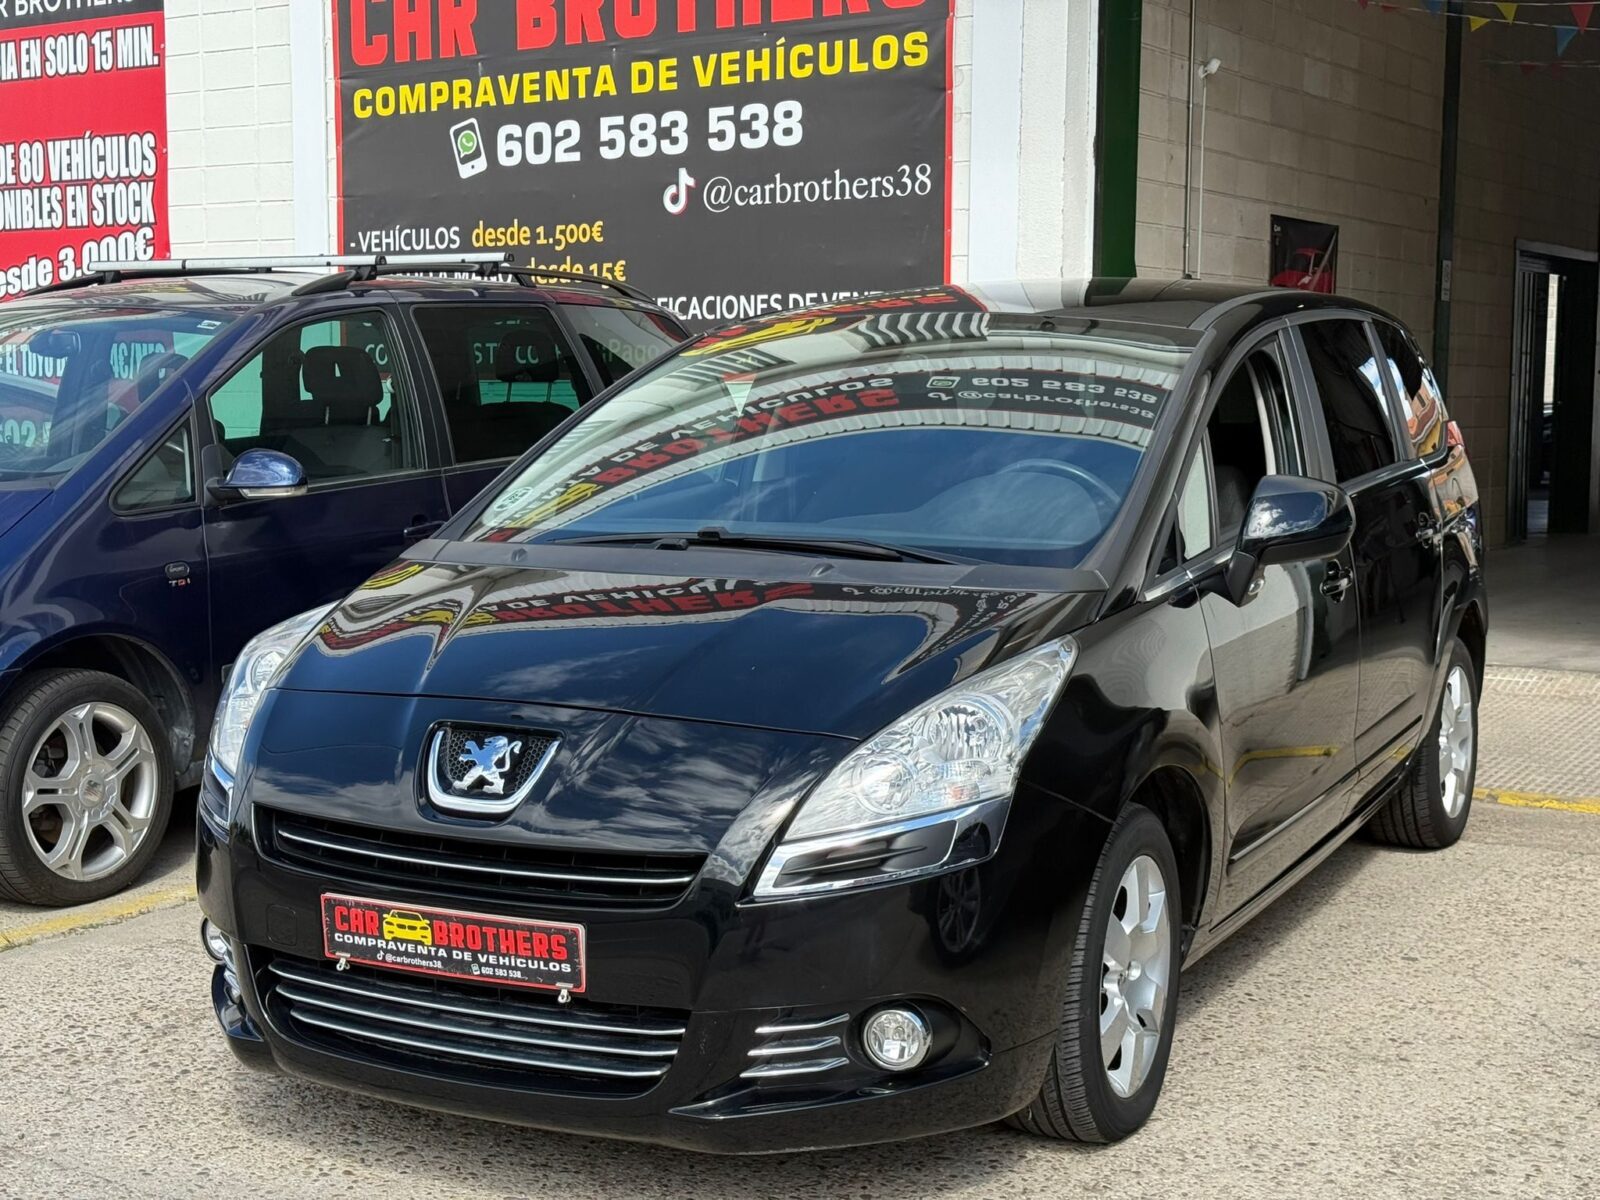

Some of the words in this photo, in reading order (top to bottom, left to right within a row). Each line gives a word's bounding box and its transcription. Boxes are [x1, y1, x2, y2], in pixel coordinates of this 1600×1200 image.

[0, 41, 18, 81] IA
[20, 38, 42, 79] EN
[44, 32, 88, 76] SOLO
[91, 30, 113, 71] 15
[116, 25, 159, 69] MIN.
[351, 0, 478, 66] CAR
[353, 64, 617, 119] COMPRAVENTA
[631, 58, 678, 94] DE
[693, 31, 929, 88] VEHÍCULOS
[19, 141, 44, 184] 80
[47, 131, 157, 182] VEHÍCULOS
[497, 119, 580, 167] 602
[600, 110, 689, 160] 583
[708, 100, 803, 152] 538
[66, 185, 88, 227] EN
[92, 181, 155, 227] STOCK
[703, 163, 932, 213] @carbrothers38
[472, 219, 530, 248] desde
[535, 221, 604, 251] 1.500€
[652, 293, 783, 321] FICACIONES
[334, 905, 380, 936] CAR
[433, 920, 568, 960] BROTHERS
[334, 932, 448, 958] COMPRAVENTA
[452, 949, 473, 962] DE
[477, 952, 572, 973] VEHÍCULOS
[385, 952, 442, 969] @carbrothers38
[481, 966, 494, 975] 602
[495, 967, 508, 977] 583
[508, 968, 522, 979] 538
